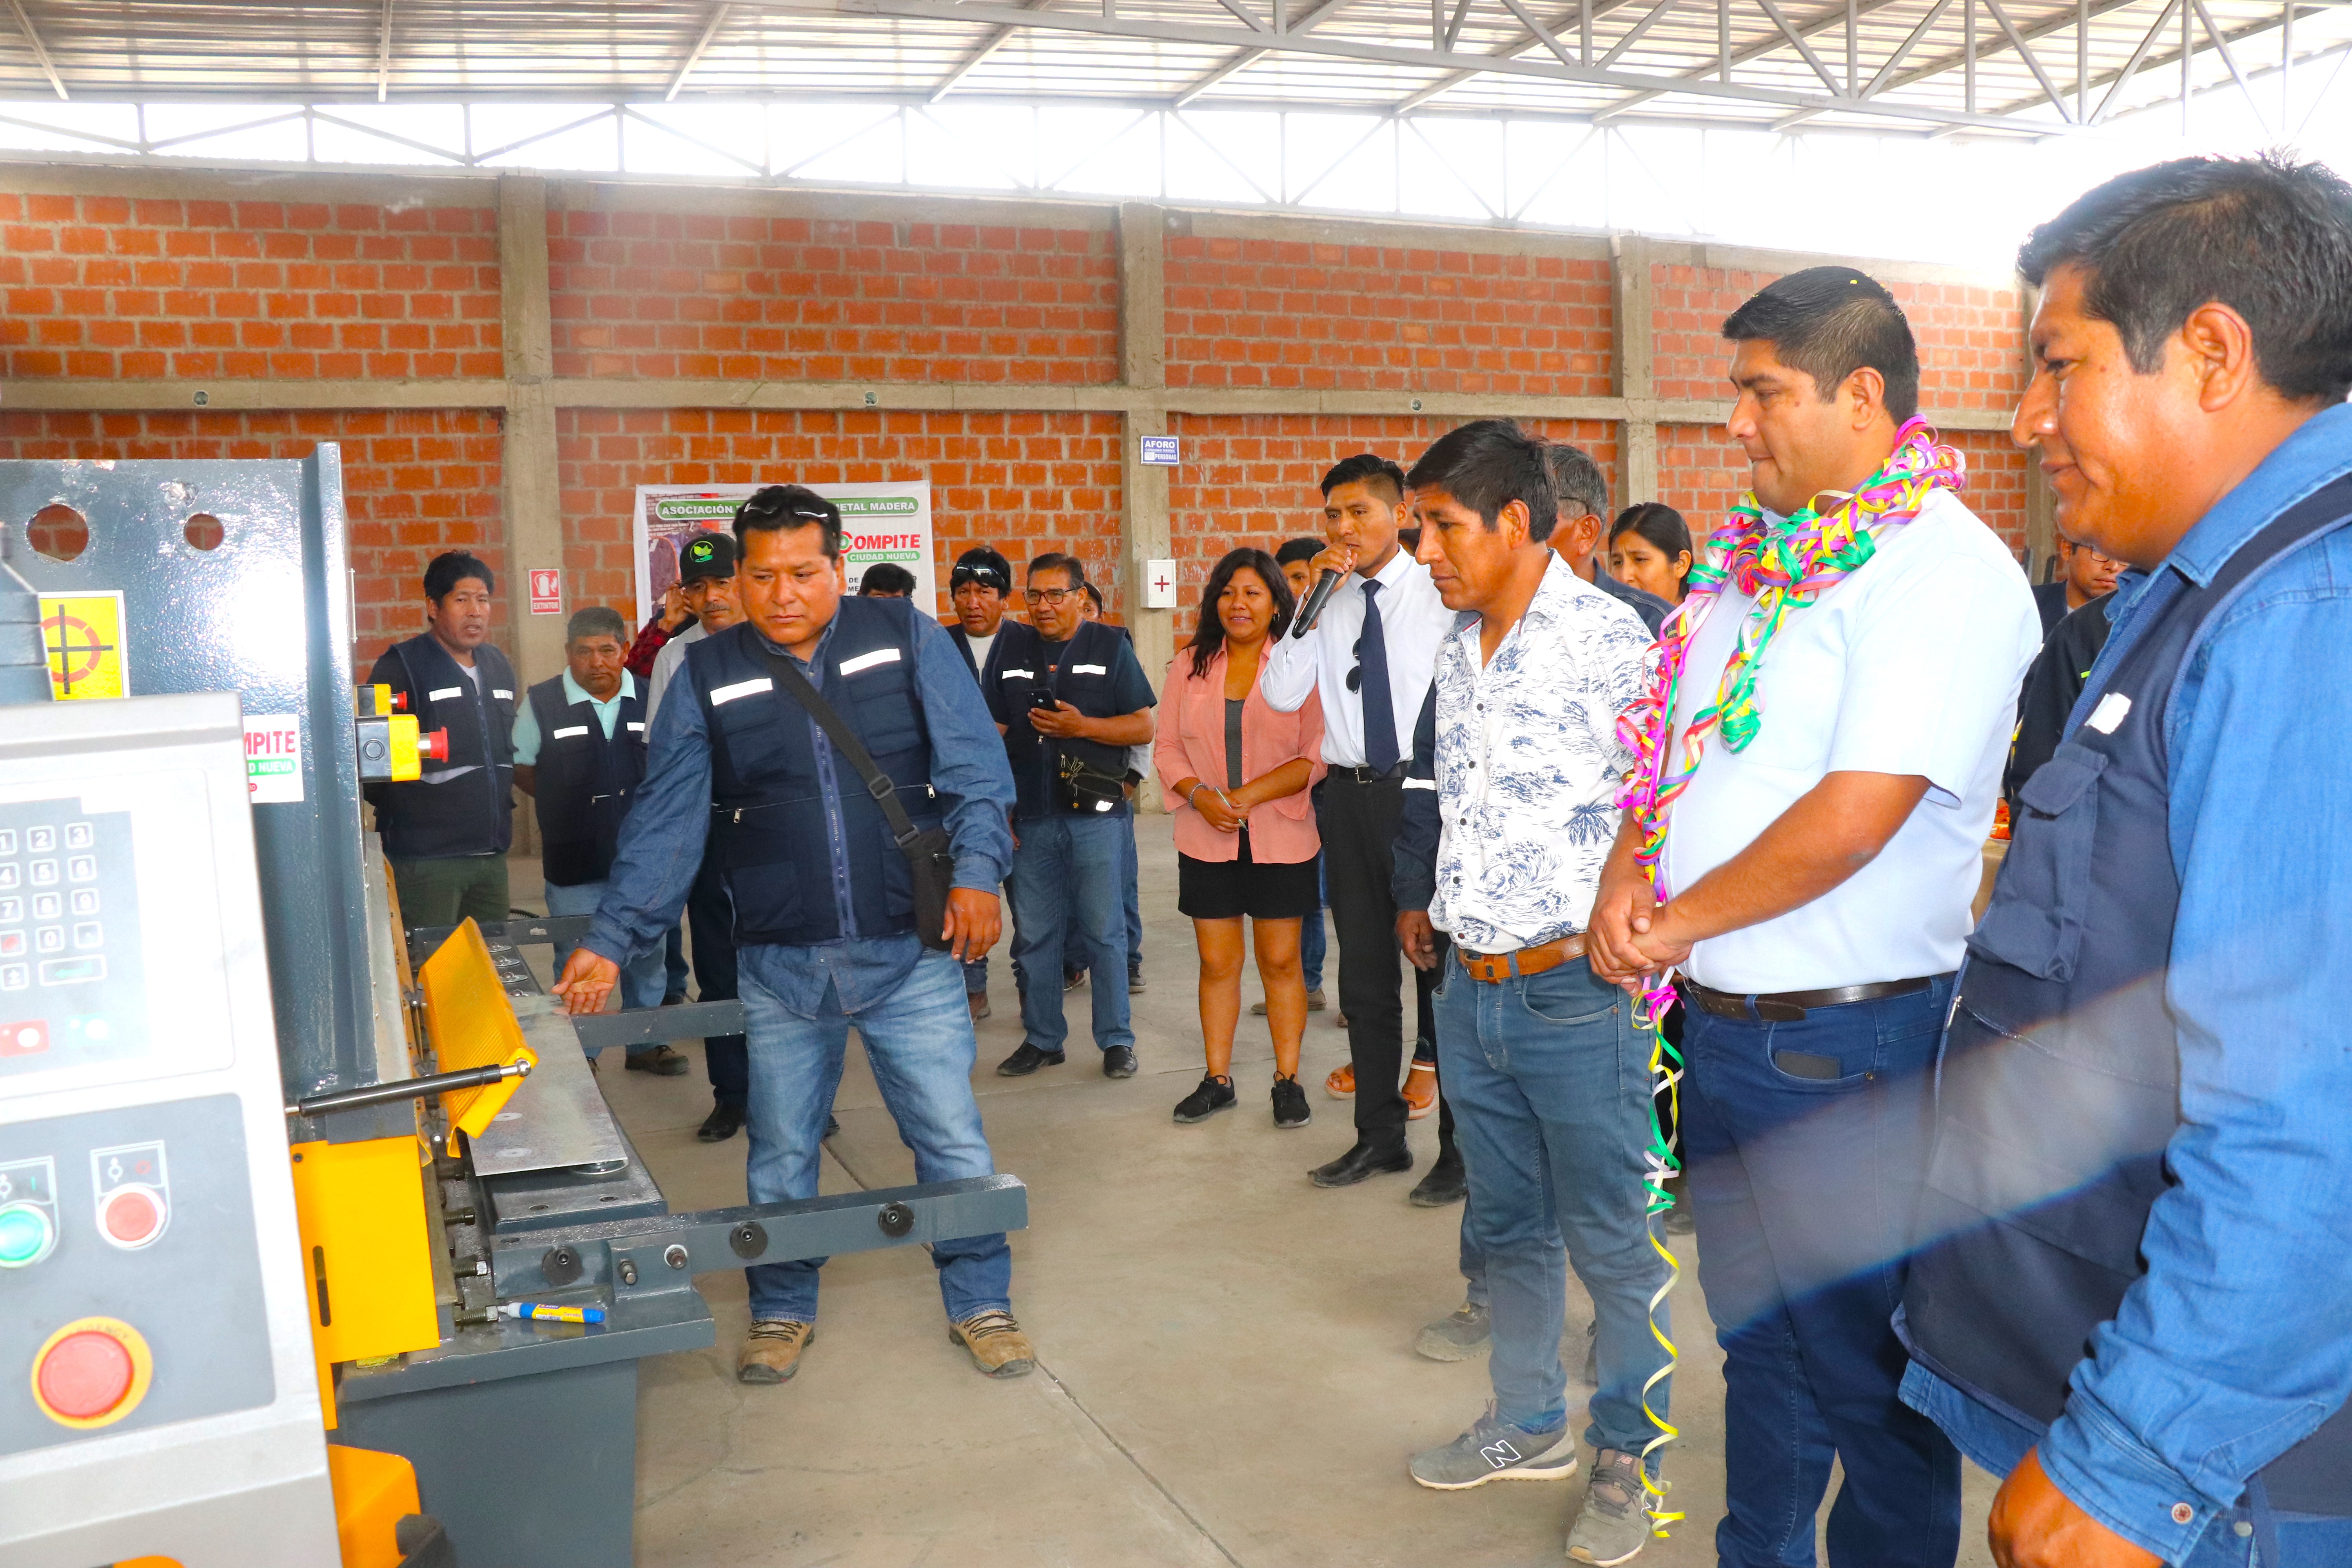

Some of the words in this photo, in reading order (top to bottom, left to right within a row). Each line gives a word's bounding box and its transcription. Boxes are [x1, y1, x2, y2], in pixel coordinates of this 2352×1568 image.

[1145, 440, 1175, 448] AFORO
[662, 504, 733, 515] ASOCIACIÓN
[869, 502, 915, 510] MADERA
[243, 731, 296, 755] MPITE
[258, 761, 293, 773] NUEVA
[35, 831, 47, 847] 2
[74, 827, 86, 844] 3
[0, 868, 11, 883] 4
[38, 864, 51, 880] 5
[4, 902, 13, 917] 7
[1480, 1439, 1521, 1468] N
